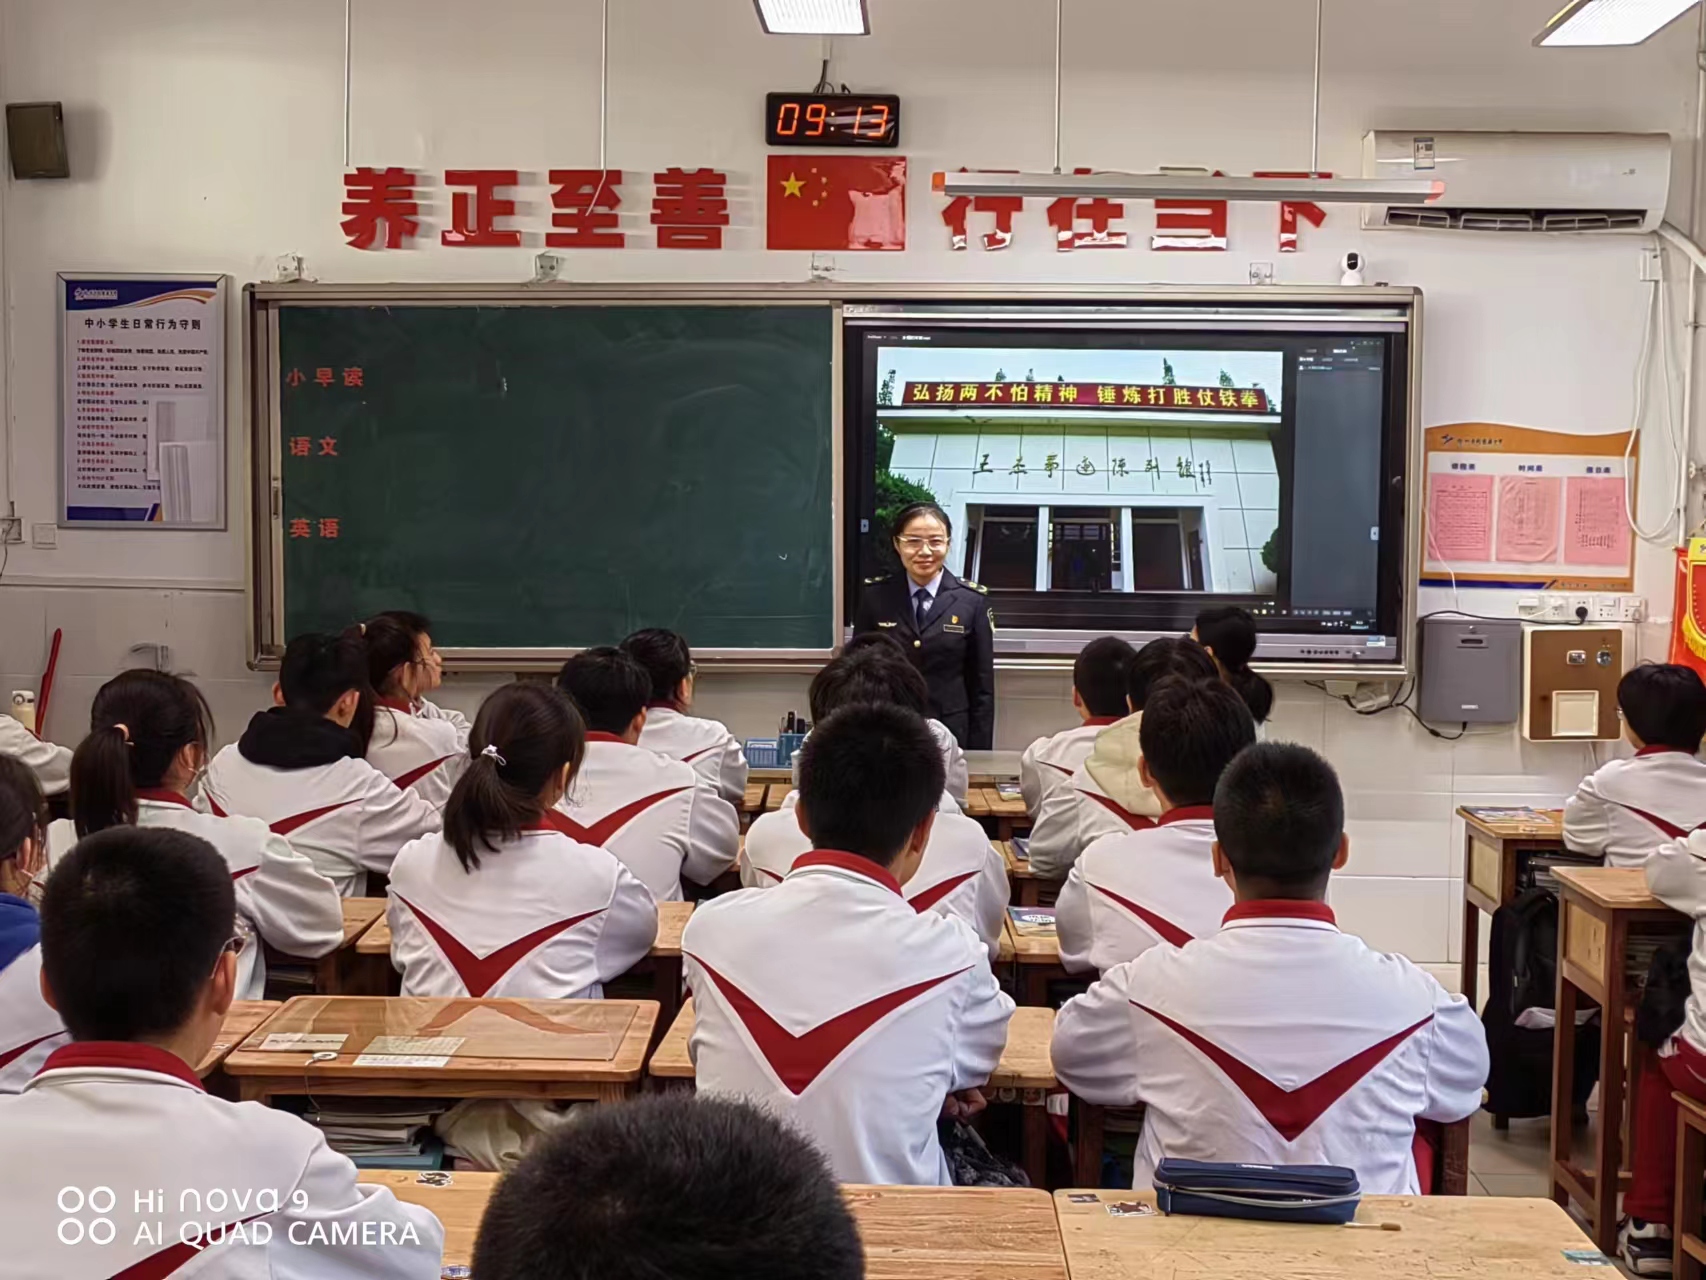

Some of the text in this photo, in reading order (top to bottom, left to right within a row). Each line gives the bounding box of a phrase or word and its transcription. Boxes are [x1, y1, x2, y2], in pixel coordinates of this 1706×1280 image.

[776, 103, 888, 137] 09:13
[340, 167, 729, 249] 养正至善
[84, 318, 201, 330] 中小学生日常行为守则
[285, 367, 364, 387] 小早读
[913, 384, 1259, 408] 弘扬两不怕精神 锤炼打胜仗铁拳
[289, 436, 338, 456] 语文
[289, 518, 340, 538] 英语
